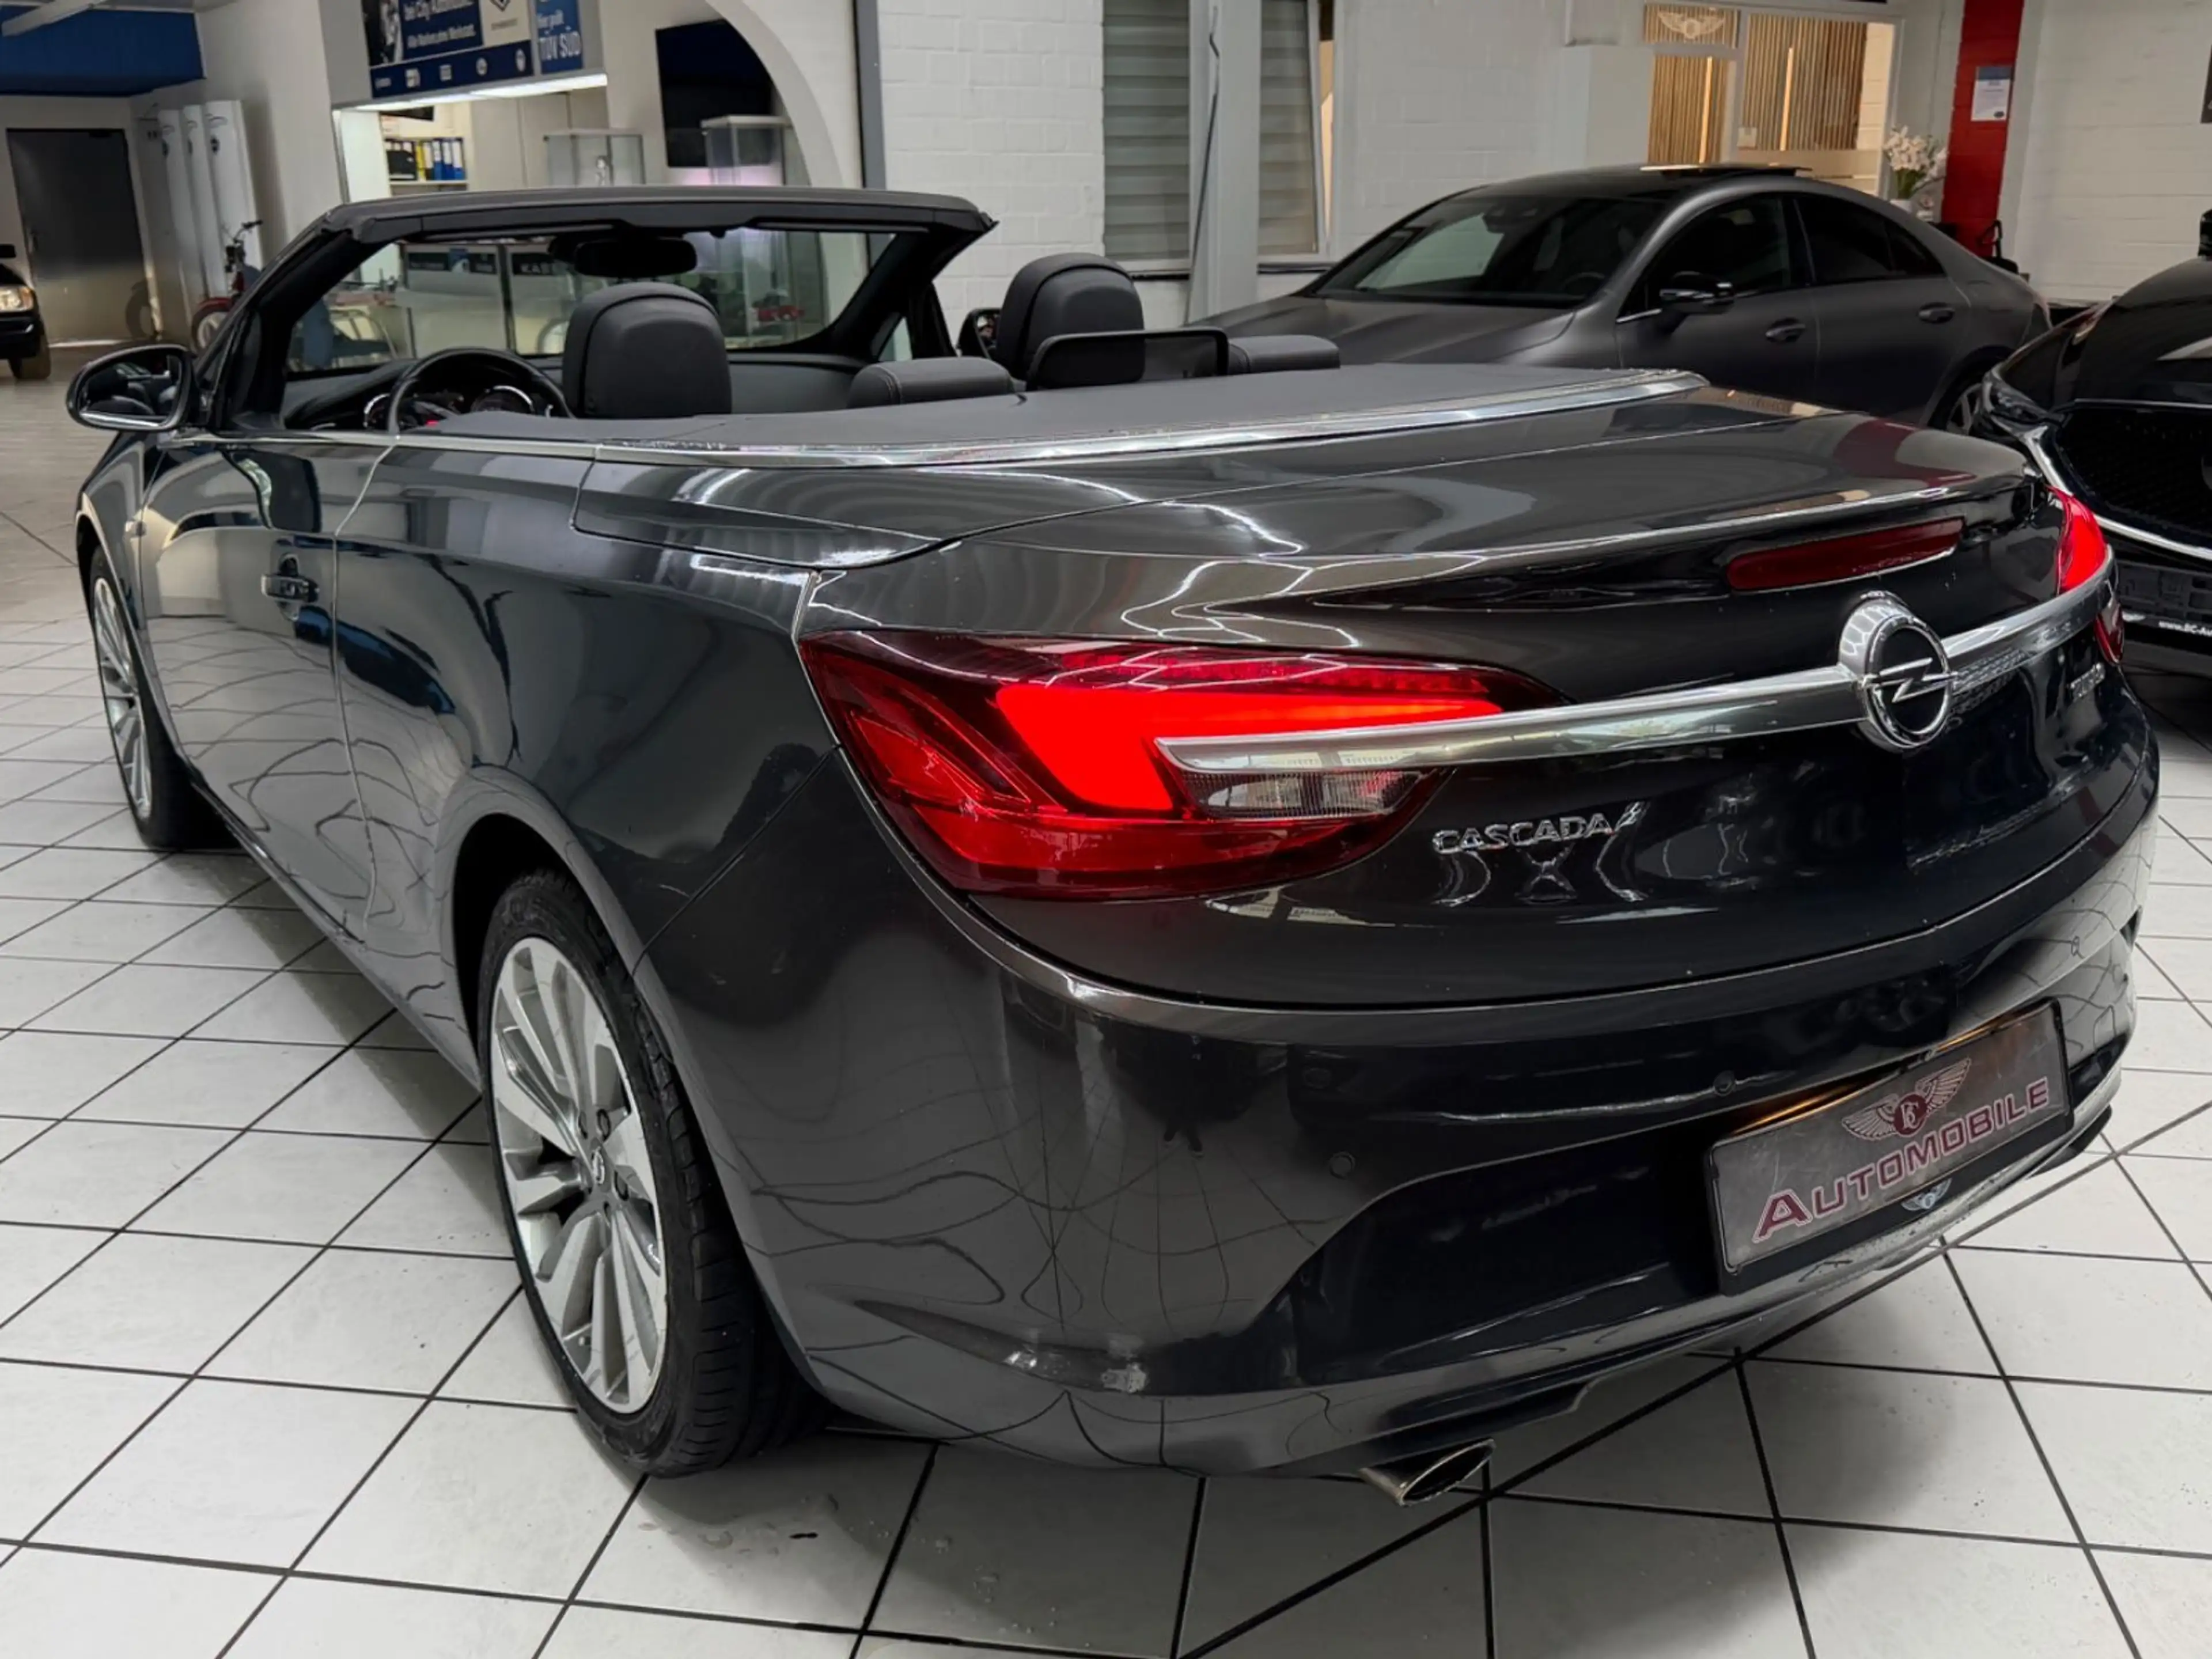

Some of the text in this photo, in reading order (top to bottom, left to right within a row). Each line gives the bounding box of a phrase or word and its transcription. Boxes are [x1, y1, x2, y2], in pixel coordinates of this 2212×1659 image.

[559, 26, 581, 58] SÜD
[1432, 812, 1613, 854] CASCADA
[1752, 1077, 2049, 1244] AUTOMOBILE
